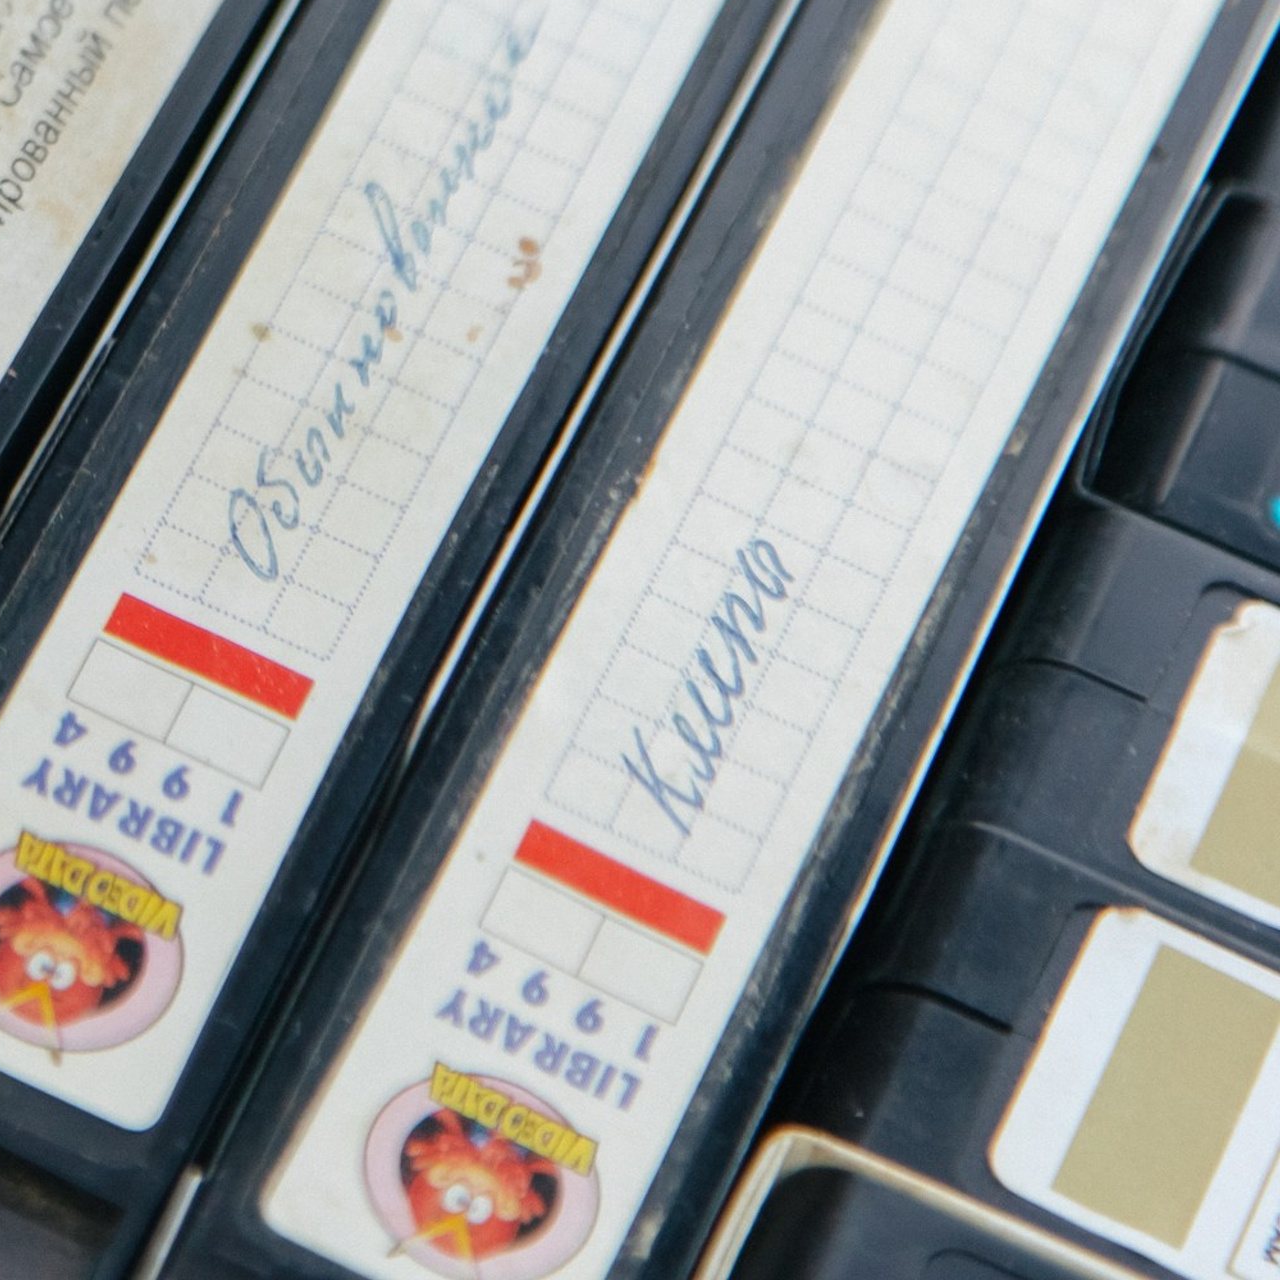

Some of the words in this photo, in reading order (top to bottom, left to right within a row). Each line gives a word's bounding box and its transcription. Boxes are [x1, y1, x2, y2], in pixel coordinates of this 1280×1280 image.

[621, 538, 796, 837] Клипы
[21, 756, 226, 877] LIBRARY
[434, 987, 643, 1112] LIBRARY
